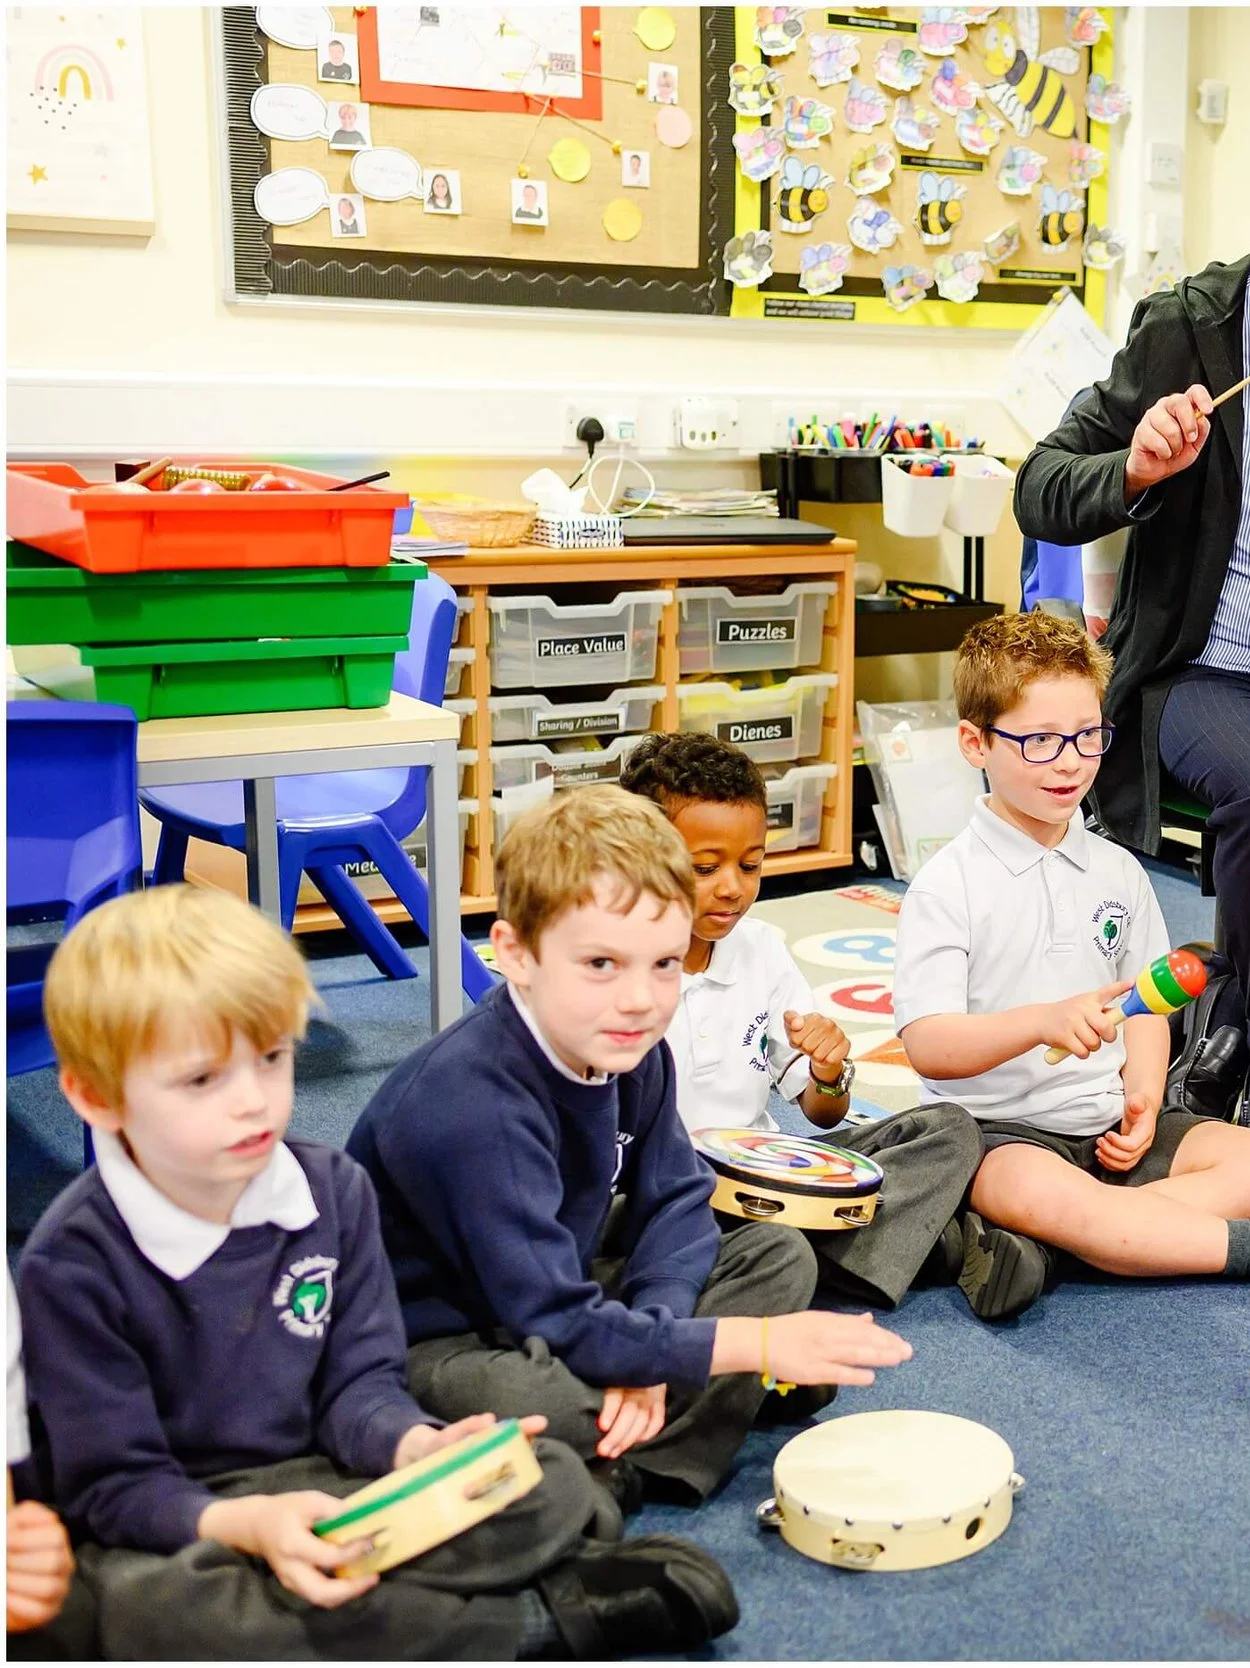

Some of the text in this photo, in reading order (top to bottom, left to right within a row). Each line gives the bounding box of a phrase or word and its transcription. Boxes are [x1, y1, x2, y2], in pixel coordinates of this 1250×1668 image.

[728, 622, 787, 641] Puzzles
[540, 637, 624, 657] Place Value
[539, 720, 574, 732] Sharing
[583, 715, 617, 728] Division
[730, 724, 782, 742] Dienes
[741, 1023, 758, 1047] West
